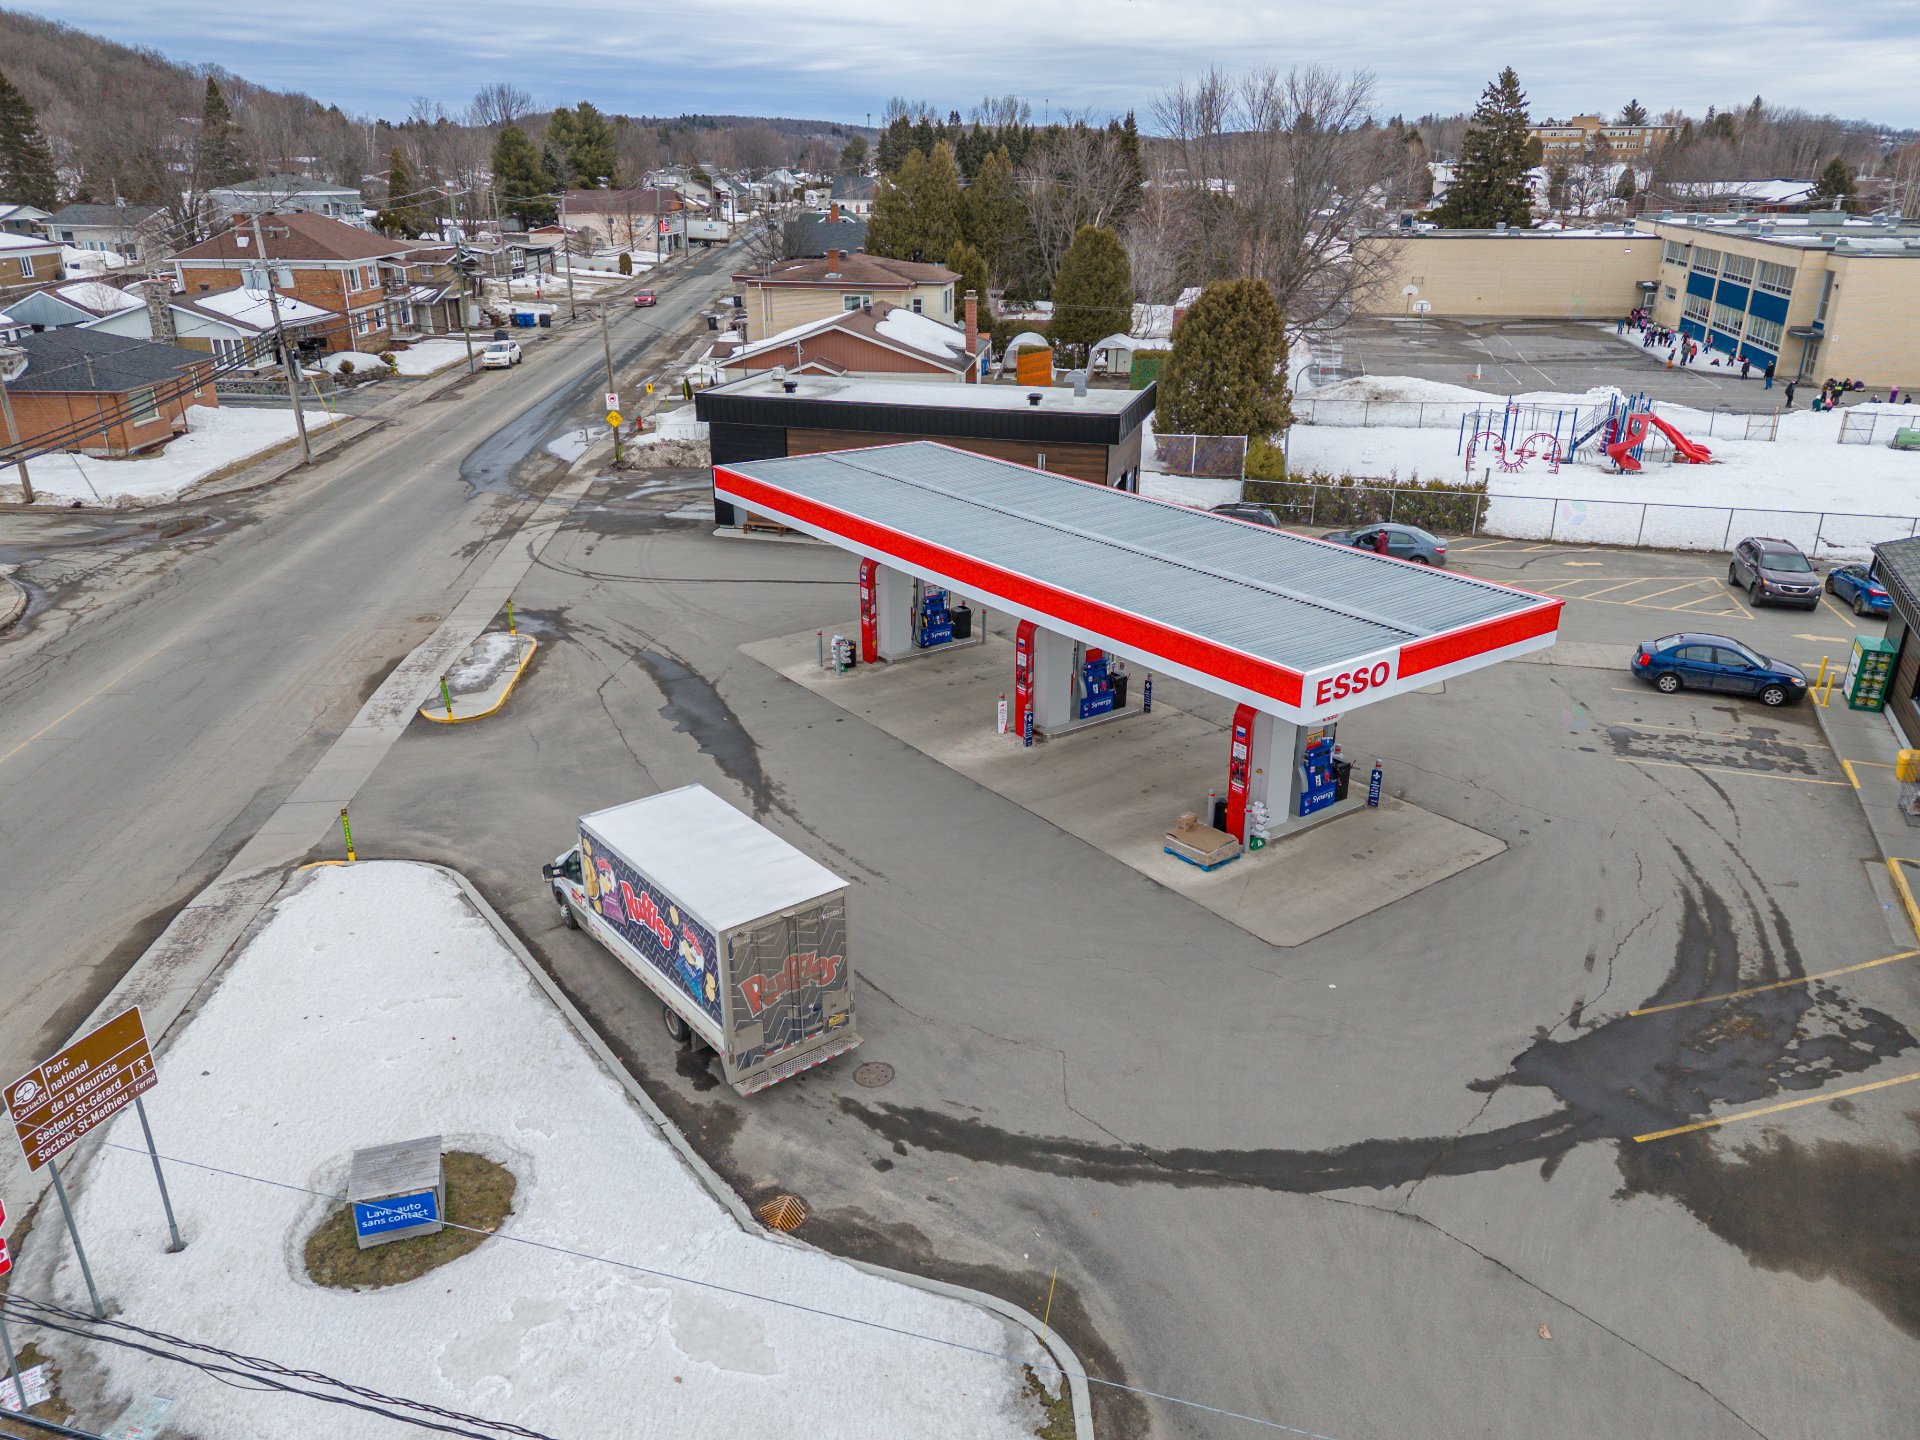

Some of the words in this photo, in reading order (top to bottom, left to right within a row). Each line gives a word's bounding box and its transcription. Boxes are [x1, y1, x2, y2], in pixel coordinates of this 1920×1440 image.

[931, 630, 951, 639] Synergy
[1316, 661, 1391, 706] ESSO
[1091, 698, 1112, 709] Synergy
[1312, 790, 1335, 803] Synergy
[619, 880, 673, 951] Ruffles
[738, 949, 842, 1018] Ruffles
[45, 1057, 70, 1078] Parc
[50, 1059, 89, 1093] national
[51, 1101, 64, 1114] de
[64, 1092, 75, 1104] la
[76, 1062, 118, 1097] Mauricie
[13, 1093, 48, 1120] Canada
[36, 1112, 74, 1145] Secteur
[75, 1078, 122, 1116] St-Gérard
[38, 1129, 76, 1162] Secteur
[77, 1092, 129, 1132] St-Mathieu
[362, 1217, 386, 1228] sans
[388, 1208, 429, 1223] contact
[367, 1203, 421, 1219] Lave-auto
